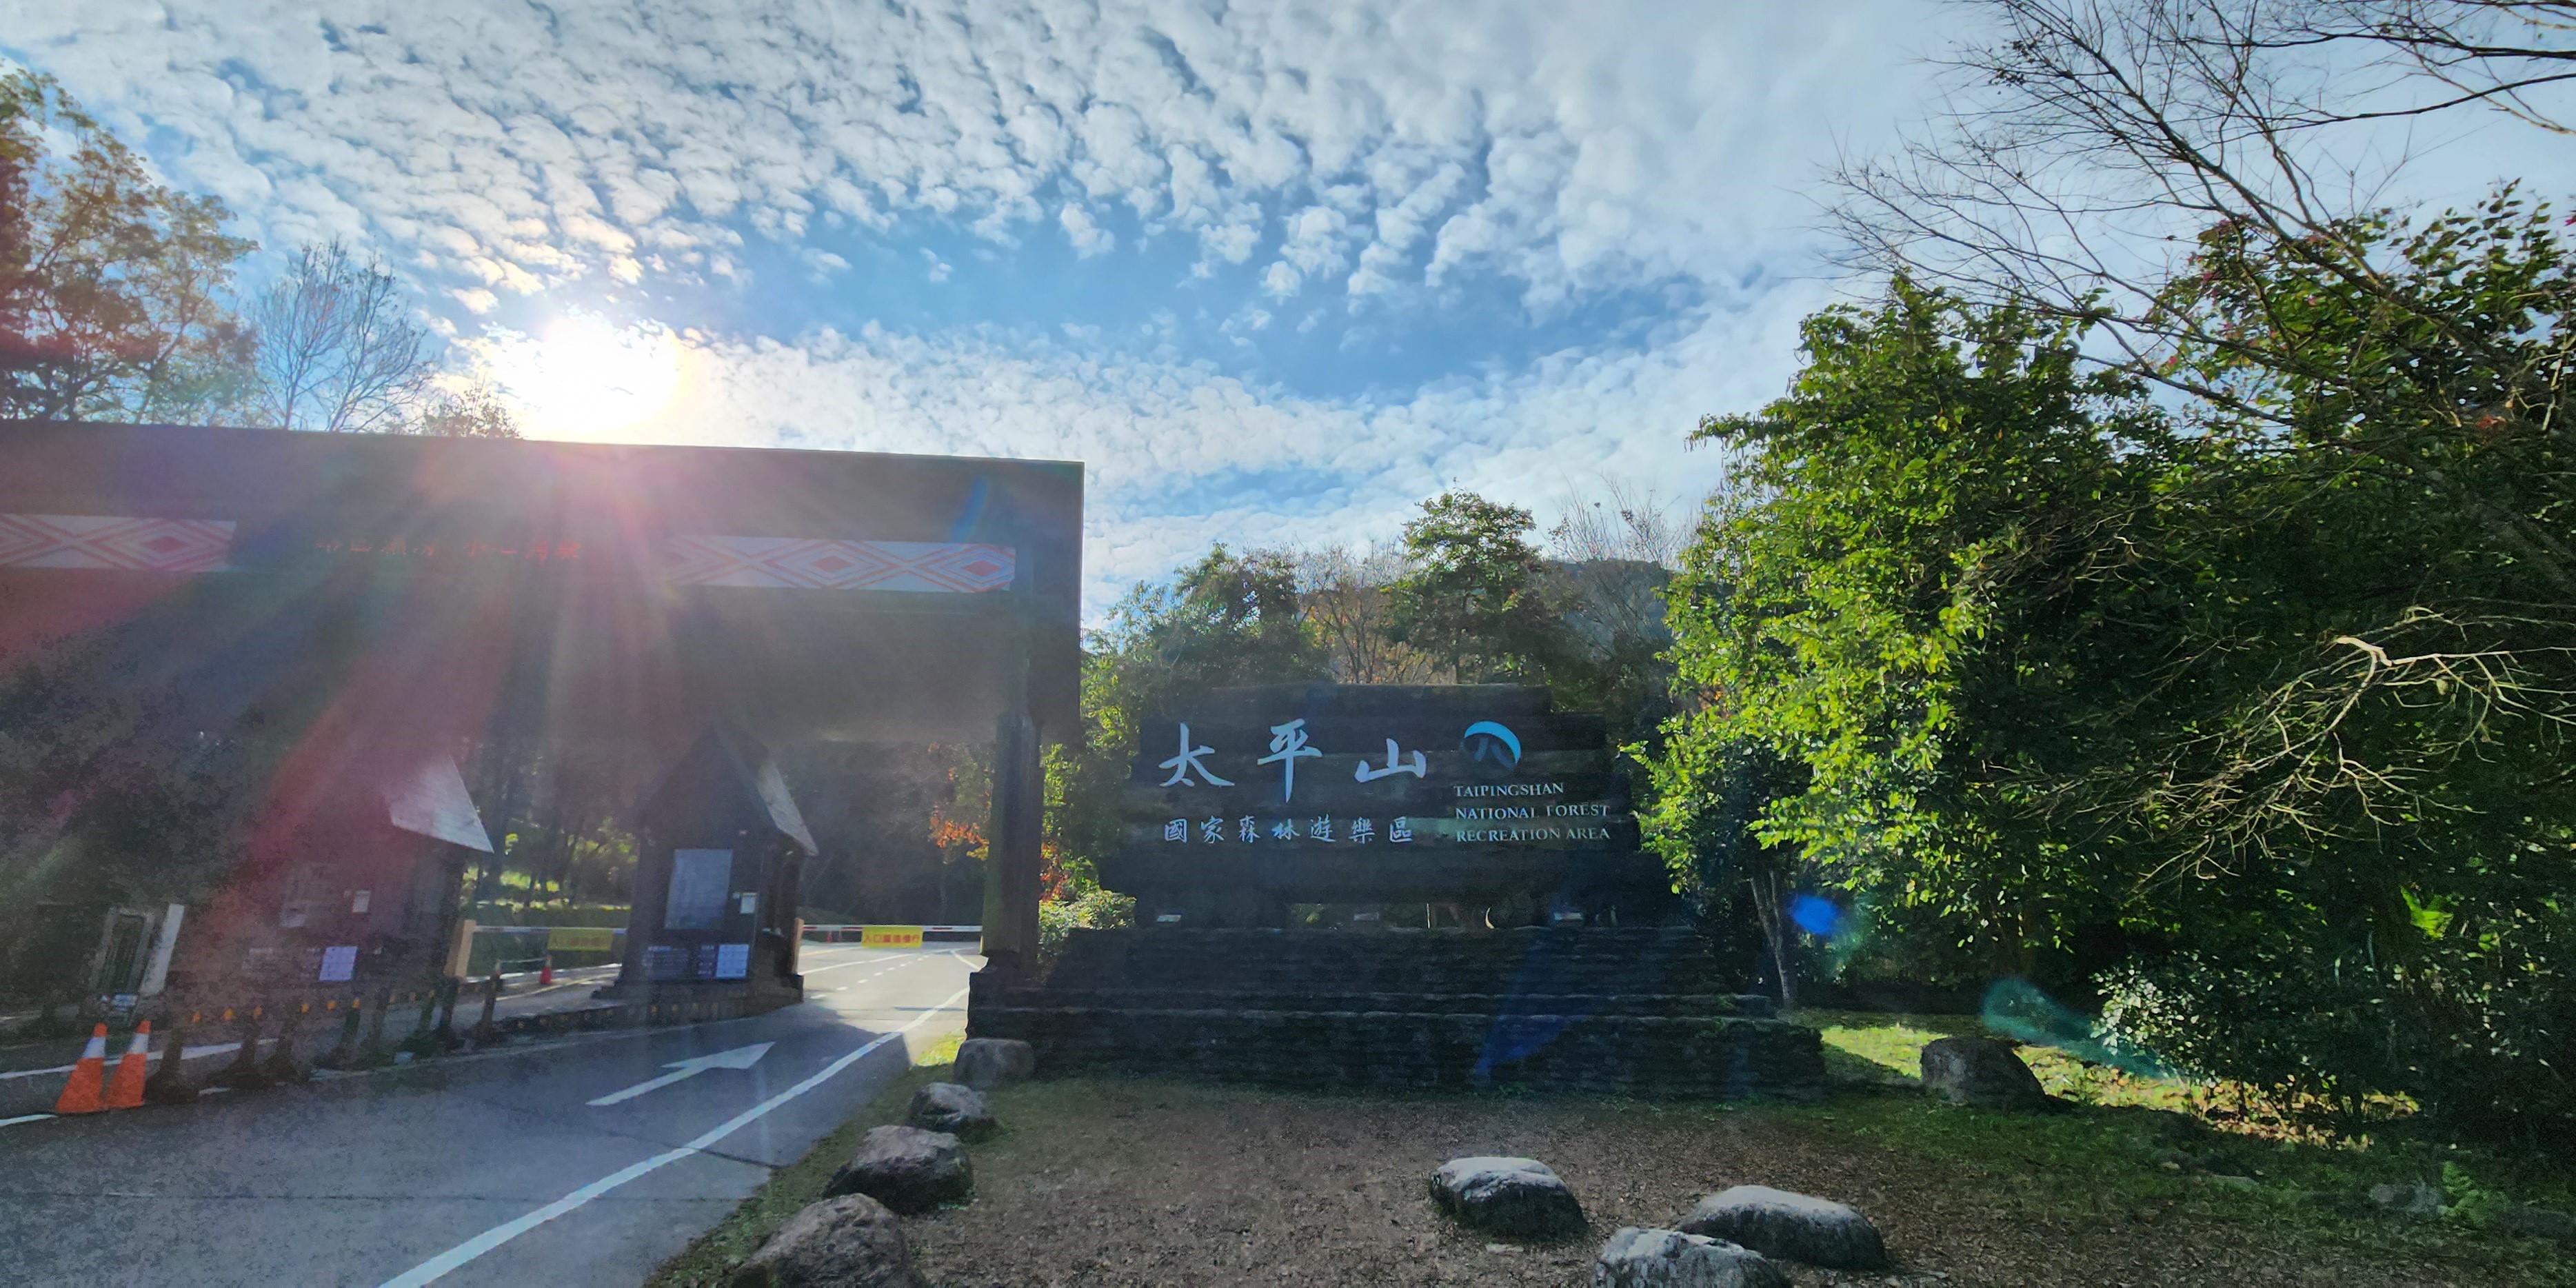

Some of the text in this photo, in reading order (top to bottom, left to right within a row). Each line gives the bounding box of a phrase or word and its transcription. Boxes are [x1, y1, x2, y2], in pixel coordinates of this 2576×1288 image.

[1158, 718, 1427, 803] 太平山
[1453, 782, 1564, 797] TAIPINGSHAN
[1456, 803, 1610, 819] NATIONAL FOREST
[1164, 814, 1413, 844] 國家森林遊樂區
[1456, 827, 1611, 843] RECREATION AREA
